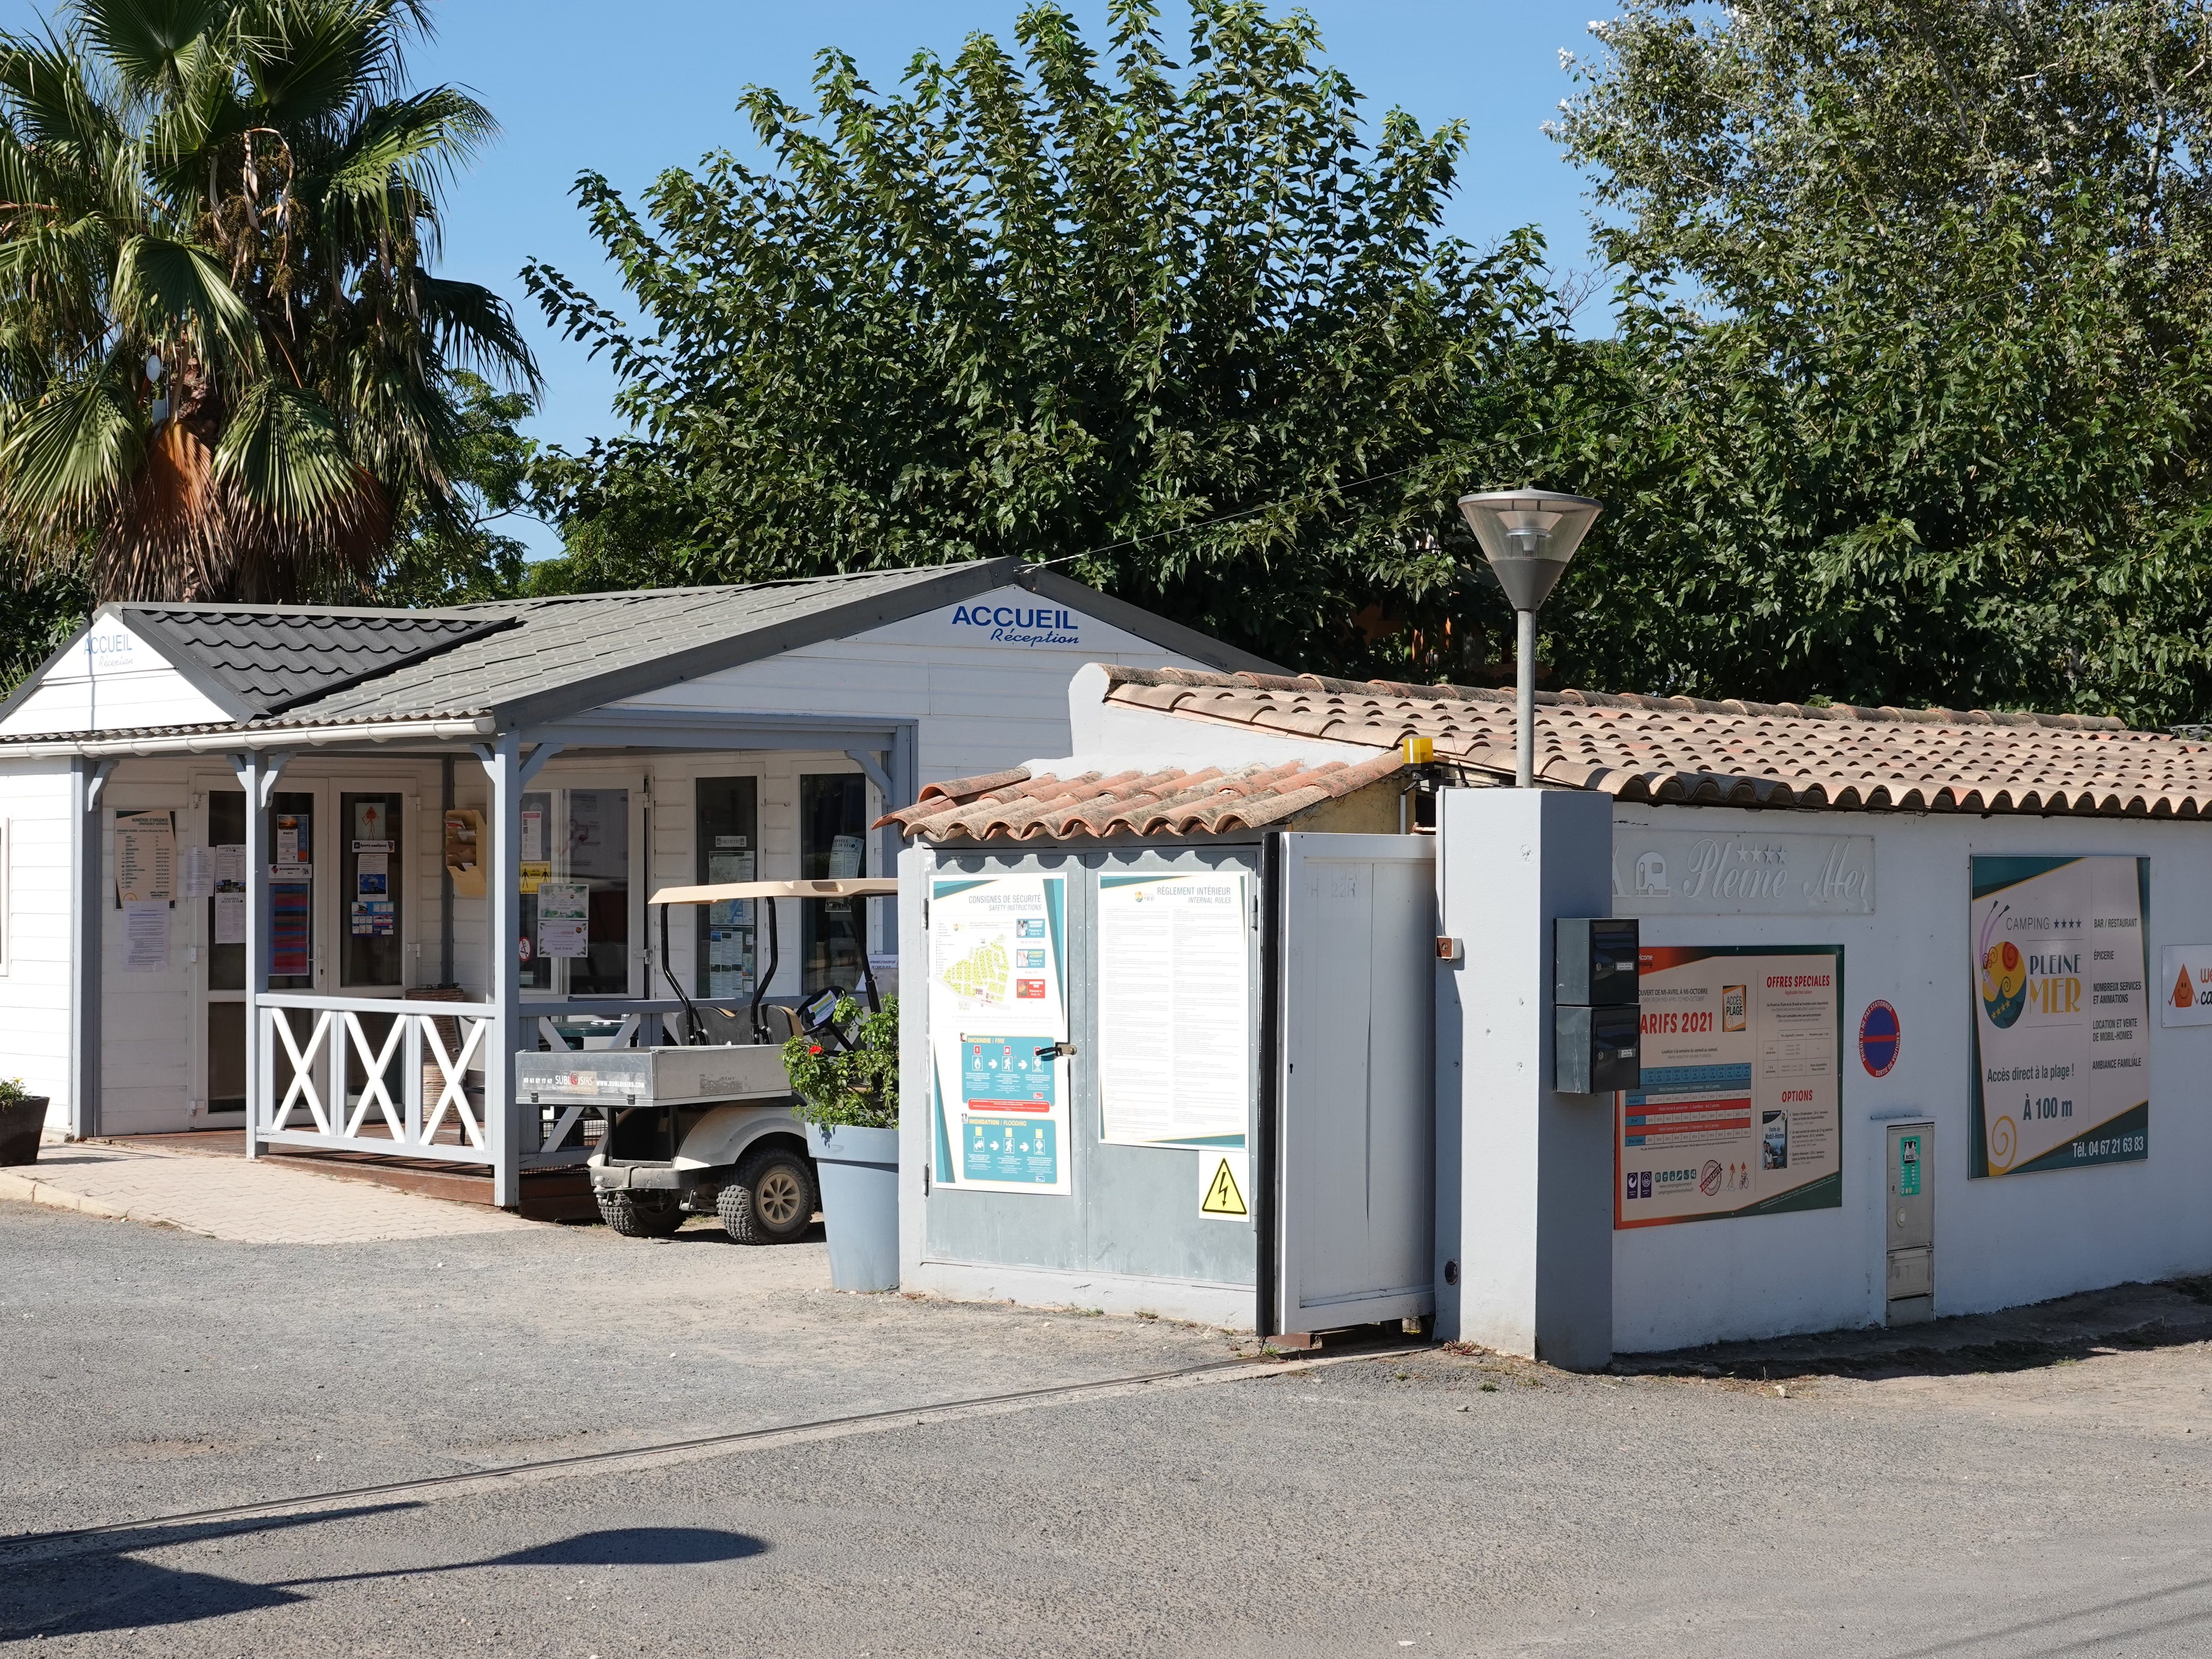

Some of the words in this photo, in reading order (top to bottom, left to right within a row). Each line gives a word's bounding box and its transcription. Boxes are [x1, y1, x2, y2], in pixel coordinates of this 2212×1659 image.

[952, 606, 1078, 629] ACCUEIL
[990, 628, 1079, 647] Réception
[84, 634, 132, 655] ACCUEIL
[99, 654, 133, 670] Réception
[1683, 838, 1788, 900] Pleine
[1802, 842, 1869, 900] Mer
[1157, 885, 1195, 895] RÈGLEMENT
[1197, 885, 1231, 895] INTÉRIEUR
[969, 895, 1001, 903] CONSIGNES
[1012, 893, 1041, 903] SÉCURITÉ
[2006, 917, 2050, 930] CAMPING
[2094, 919, 2103, 928] BAR
[2108, 918, 2137, 928] RESTAURANT
[2094, 950, 2114, 960] ÉPICERIE
[2030, 954, 2081, 975] PLEINE
[1767, 975, 1792, 988] OFFRES
[1794, 975, 1830, 987] SPECIALES
[2093, 982, 2119, 992] NOMBREUX
[2120, 981, 2142, 991] SERVICES
[1726, 994, 1742, 1005] ACCÈS
[2029, 978, 2081, 1014] MER
[2093, 995, 2099, 1004] ET
[2100, 994, 2128, 1004] ANIMATIONS
[1726, 1005, 1743, 1016] PLAGE
[1870, 1000, 1892, 1012] STATIONNER
[1640, 1013, 1678, 1034] ARIFS
[1681, 1011, 1713, 1033] 2021
[1861, 1018, 1866, 1029] NE
[2093, 1019, 2115, 1029] LOCATION
[2116, 1019, 2122, 1028] ET
[2123, 1018, 2137, 1027] VENTE
[1860, 1030, 1864, 1038] DE
[2093, 1032, 2099, 1041] DE
[2100, 1031, 2132, 1041] MOBIL-HOMES
[1875, 1066, 1889, 1076] SORTIE
[1888, 1061, 1893, 1070] DE
[1891, 1032, 1900, 1061] VOITURES
[2092, 1059, 2116, 1070] AMBIANCE
[2117, 1057, 2142, 1068] FAMILIALE
[1987, 1069, 2010, 1082] Accès
[2012, 1067, 2033, 1081] direct
[2035, 1065, 2040, 1078] à
[2041, 1065, 2048, 1078] la
[2051, 1064, 2070, 1081] plage
[1782, 1089, 1813, 1102] OPTIONS
[2023, 1093, 2031, 1120] À
[2036, 1097, 2058, 1119] 100
[2061, 1100, 2073, 1117] m
[2072, 1142, 2086, 1158] Tél.
[2089, 1141, 2099, 1156] 04
[2100, 1140, 2110, 1155] 67
[2111, 1138, 2120, 1154] 21
[2123, 1137, 2132, 1152] 63
[2134, 1136, 2144, 1151] 83
